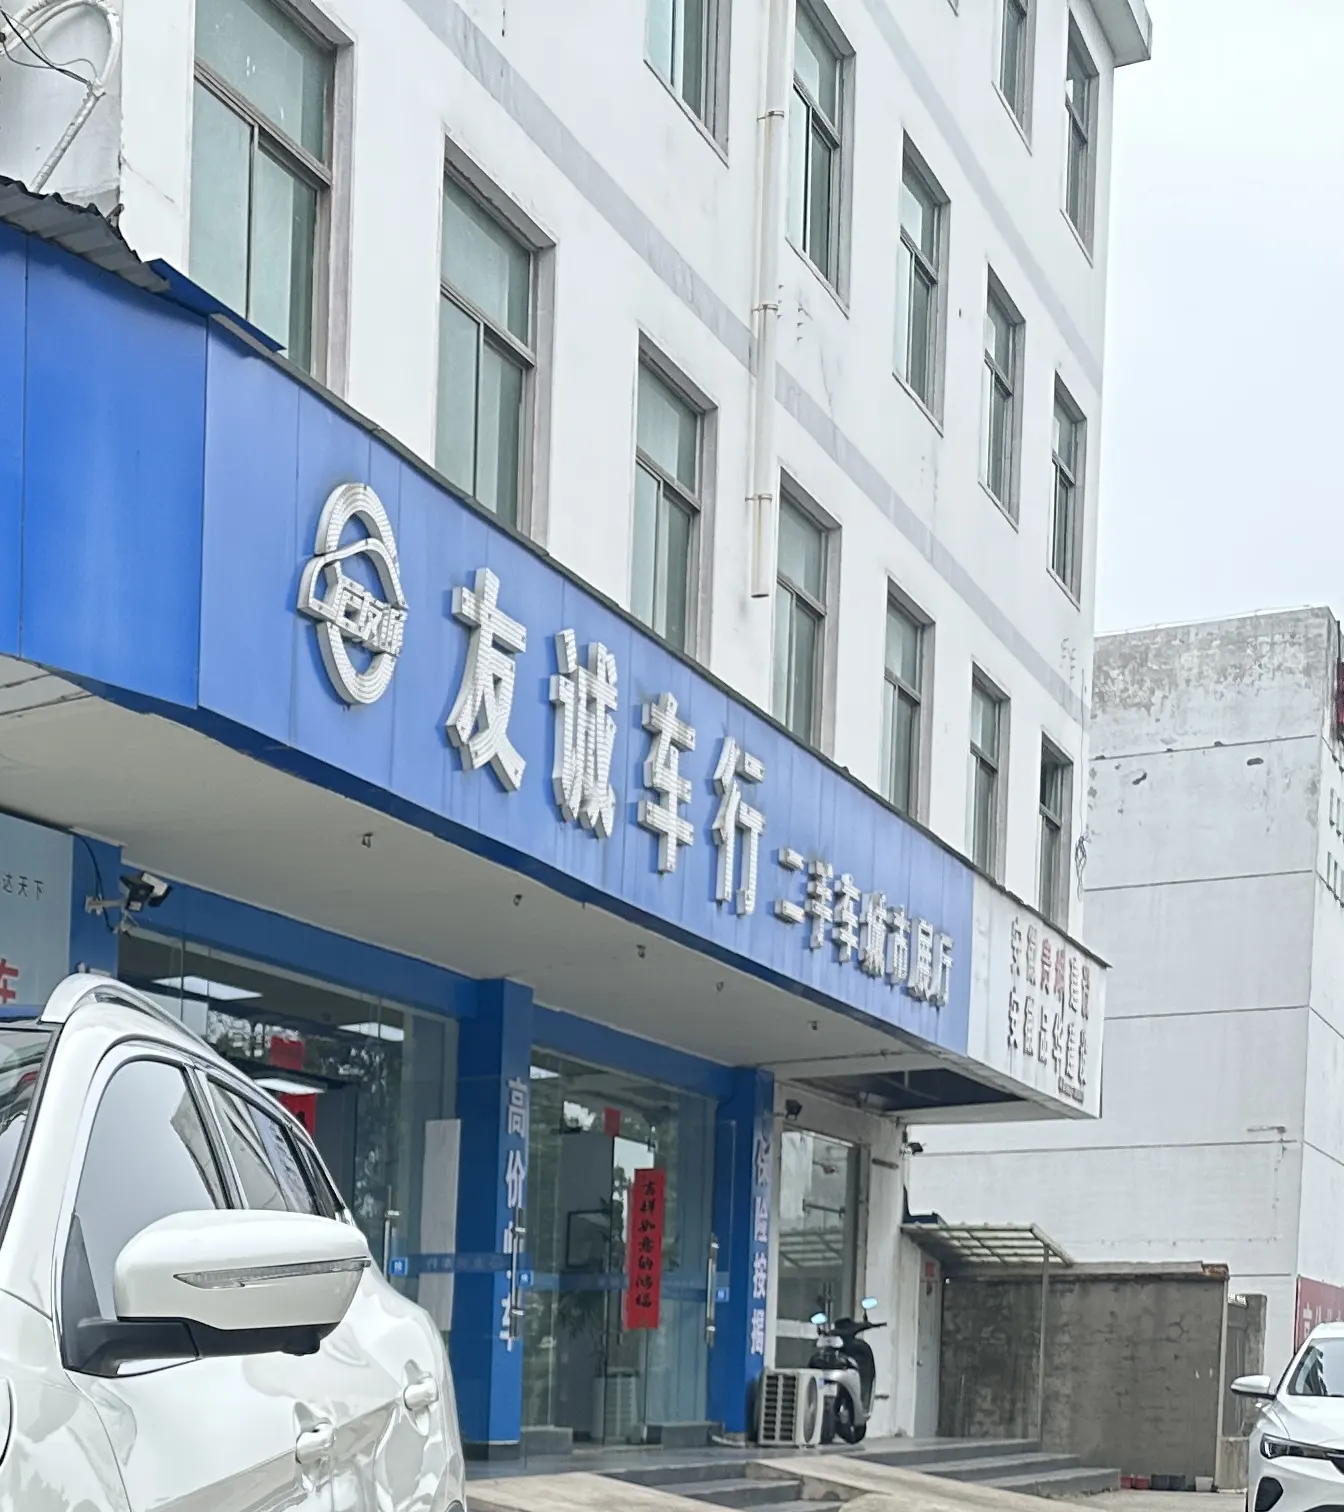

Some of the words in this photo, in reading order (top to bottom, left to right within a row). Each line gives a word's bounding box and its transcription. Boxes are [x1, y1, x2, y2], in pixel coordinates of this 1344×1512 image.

[446, 567, 766, 915] 友诚车行
[774, 848, 955, 1009] 二手车城市展厅
